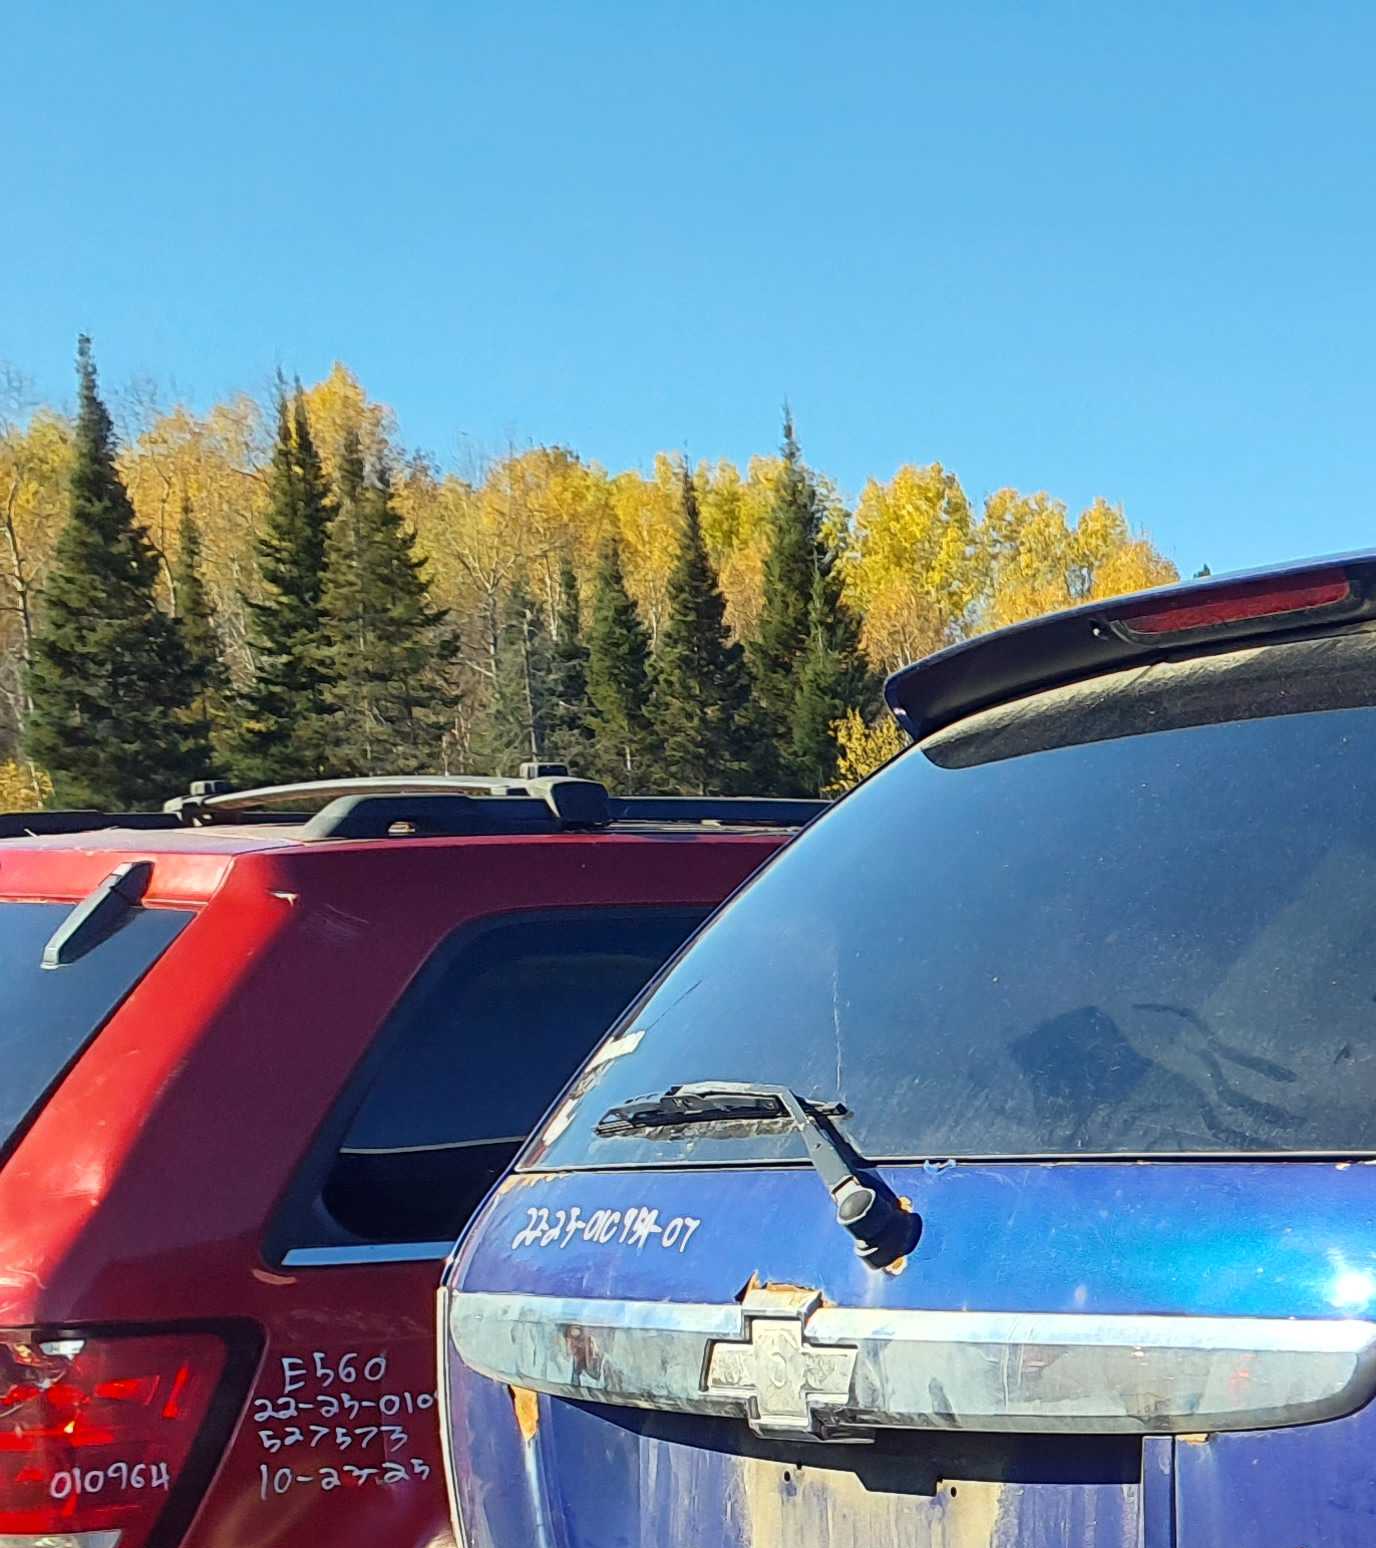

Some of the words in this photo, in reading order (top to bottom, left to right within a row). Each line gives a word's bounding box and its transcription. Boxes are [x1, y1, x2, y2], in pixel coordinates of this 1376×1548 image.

[281, 1351, 388, 1395] E560
[253, 1391, 438, 1422] 22-25-010
[257, 1424, 409, 1453] 527573
[50, 1460, 172, 1499] 010964
